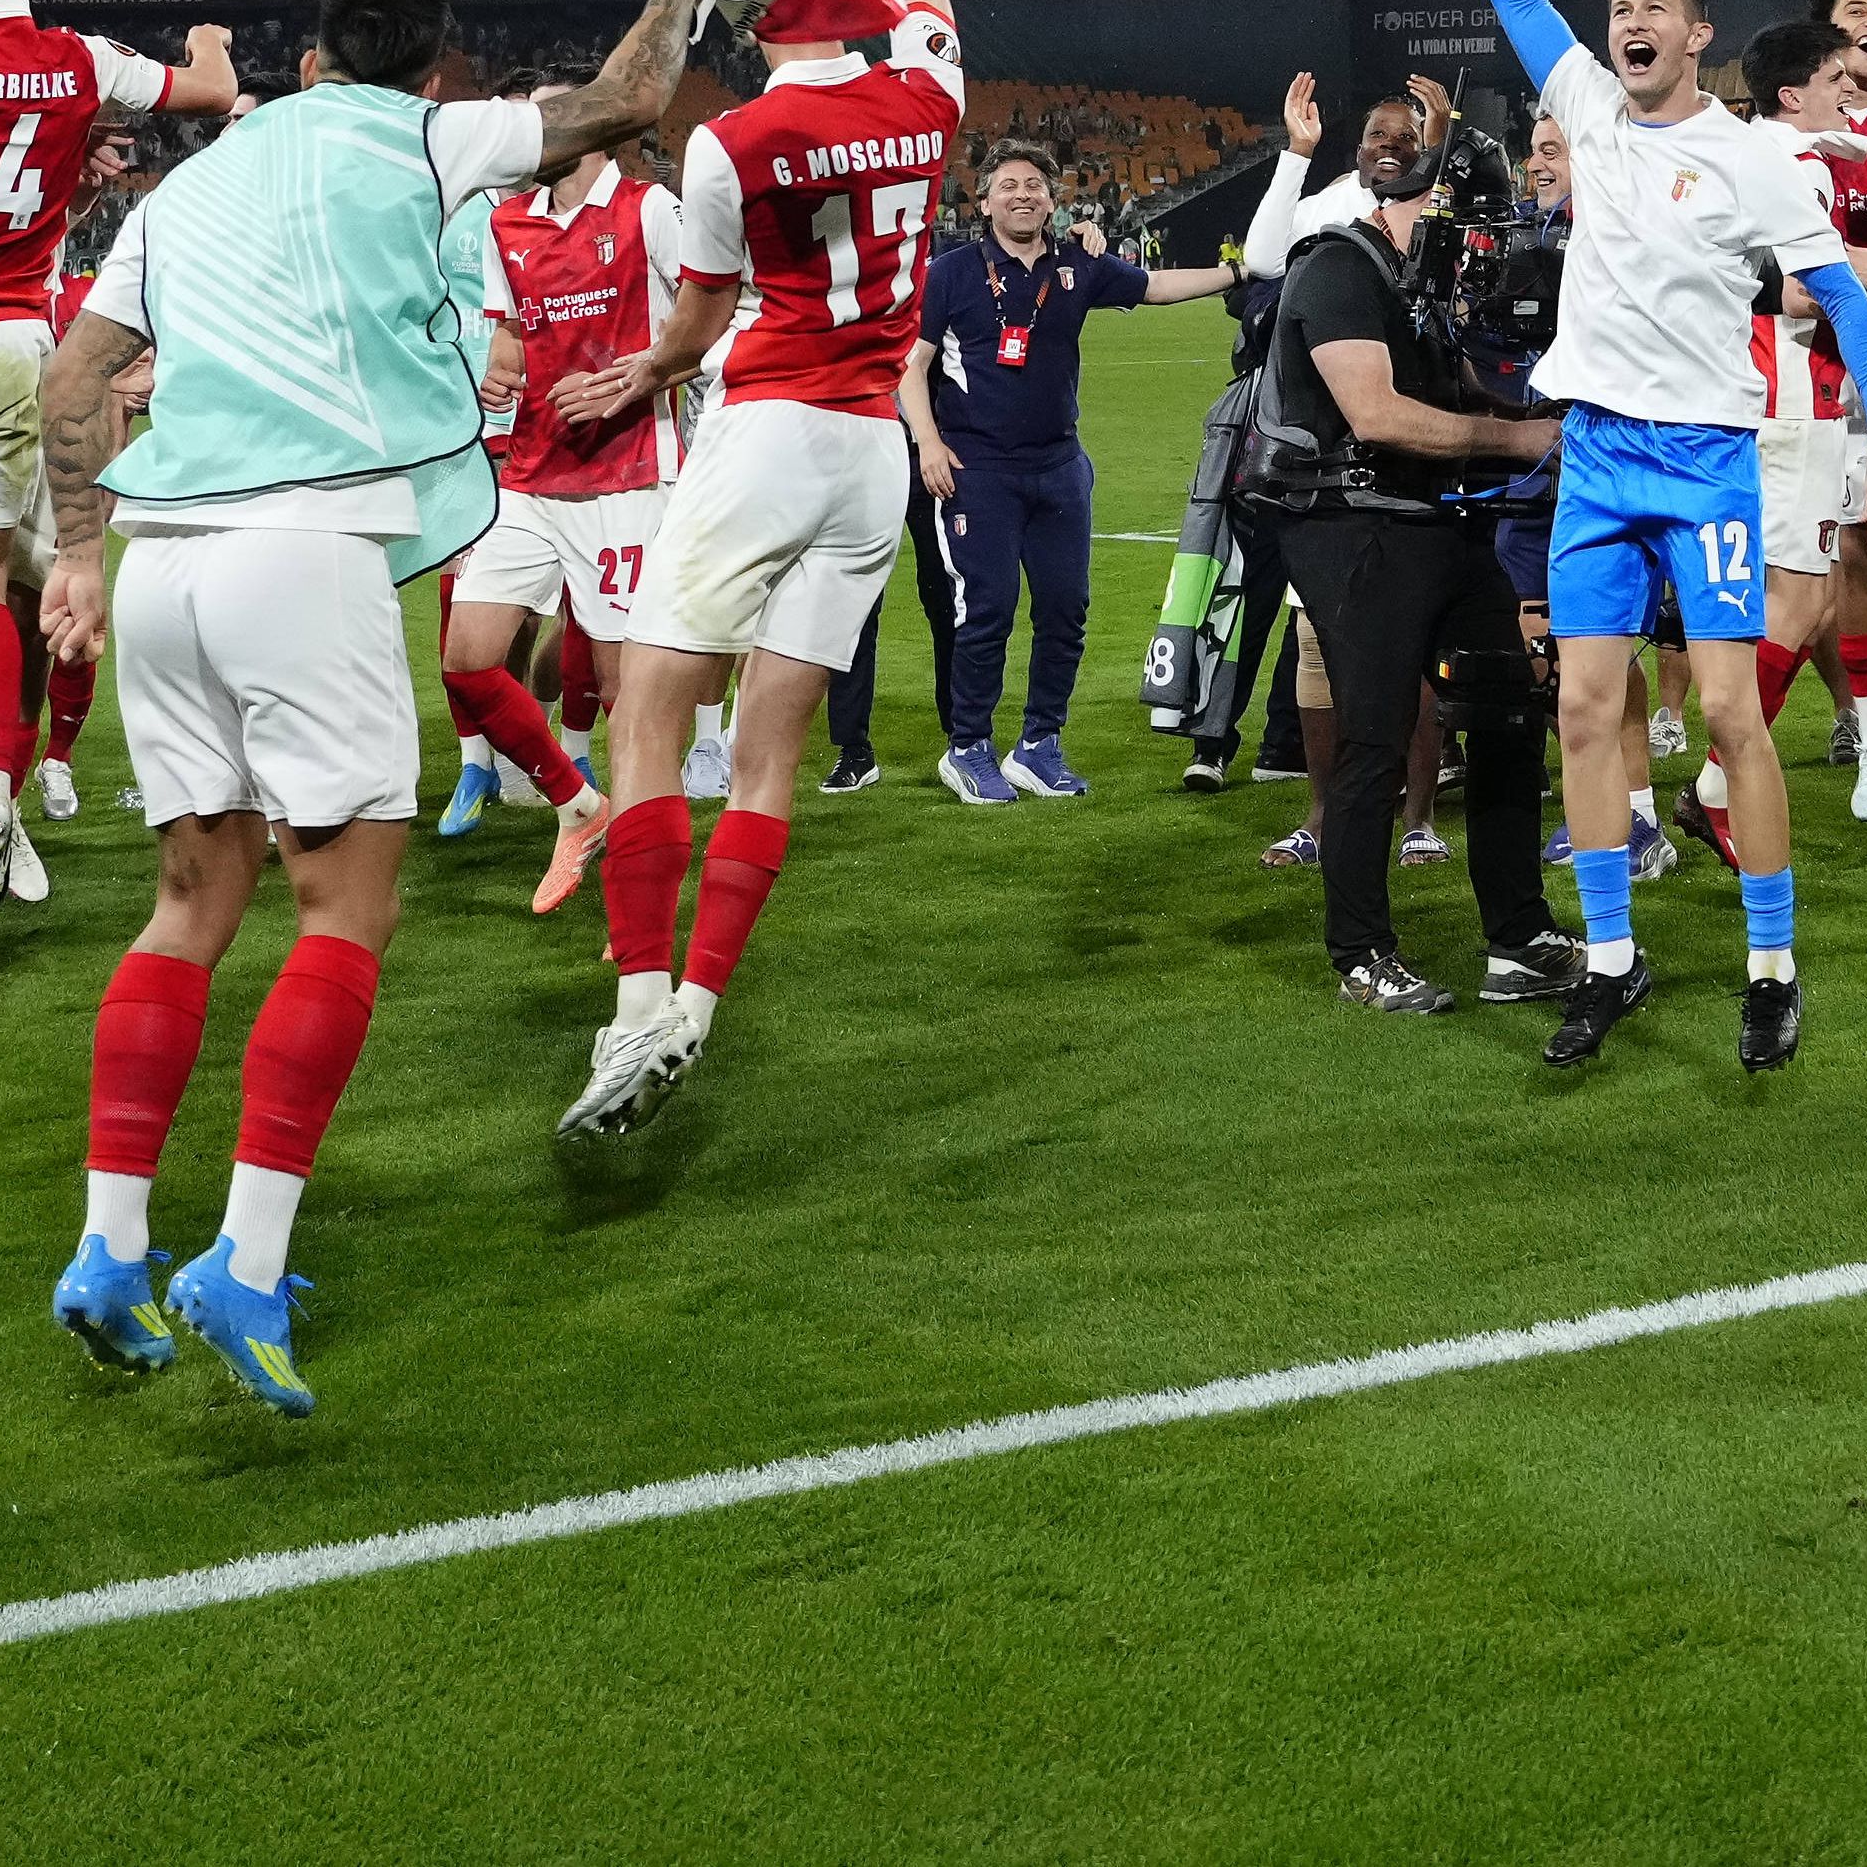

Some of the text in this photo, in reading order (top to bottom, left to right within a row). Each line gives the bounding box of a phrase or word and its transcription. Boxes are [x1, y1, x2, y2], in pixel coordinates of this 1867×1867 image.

[1374, 9, 1465, 31] FOREVER
[1408, 39, 1422, 56] LA
[1448, 37, 1463, 54] EN
[805, 130, 944, 182] MOSCARDO
[811, 178, 931, 329] 17
[543, 286, 619, 312] Portuguese
[547, 302, 608, 324] Red Cross
[597, 544, 644, 596] 27
[1698, 520, 1752, 584] 12
